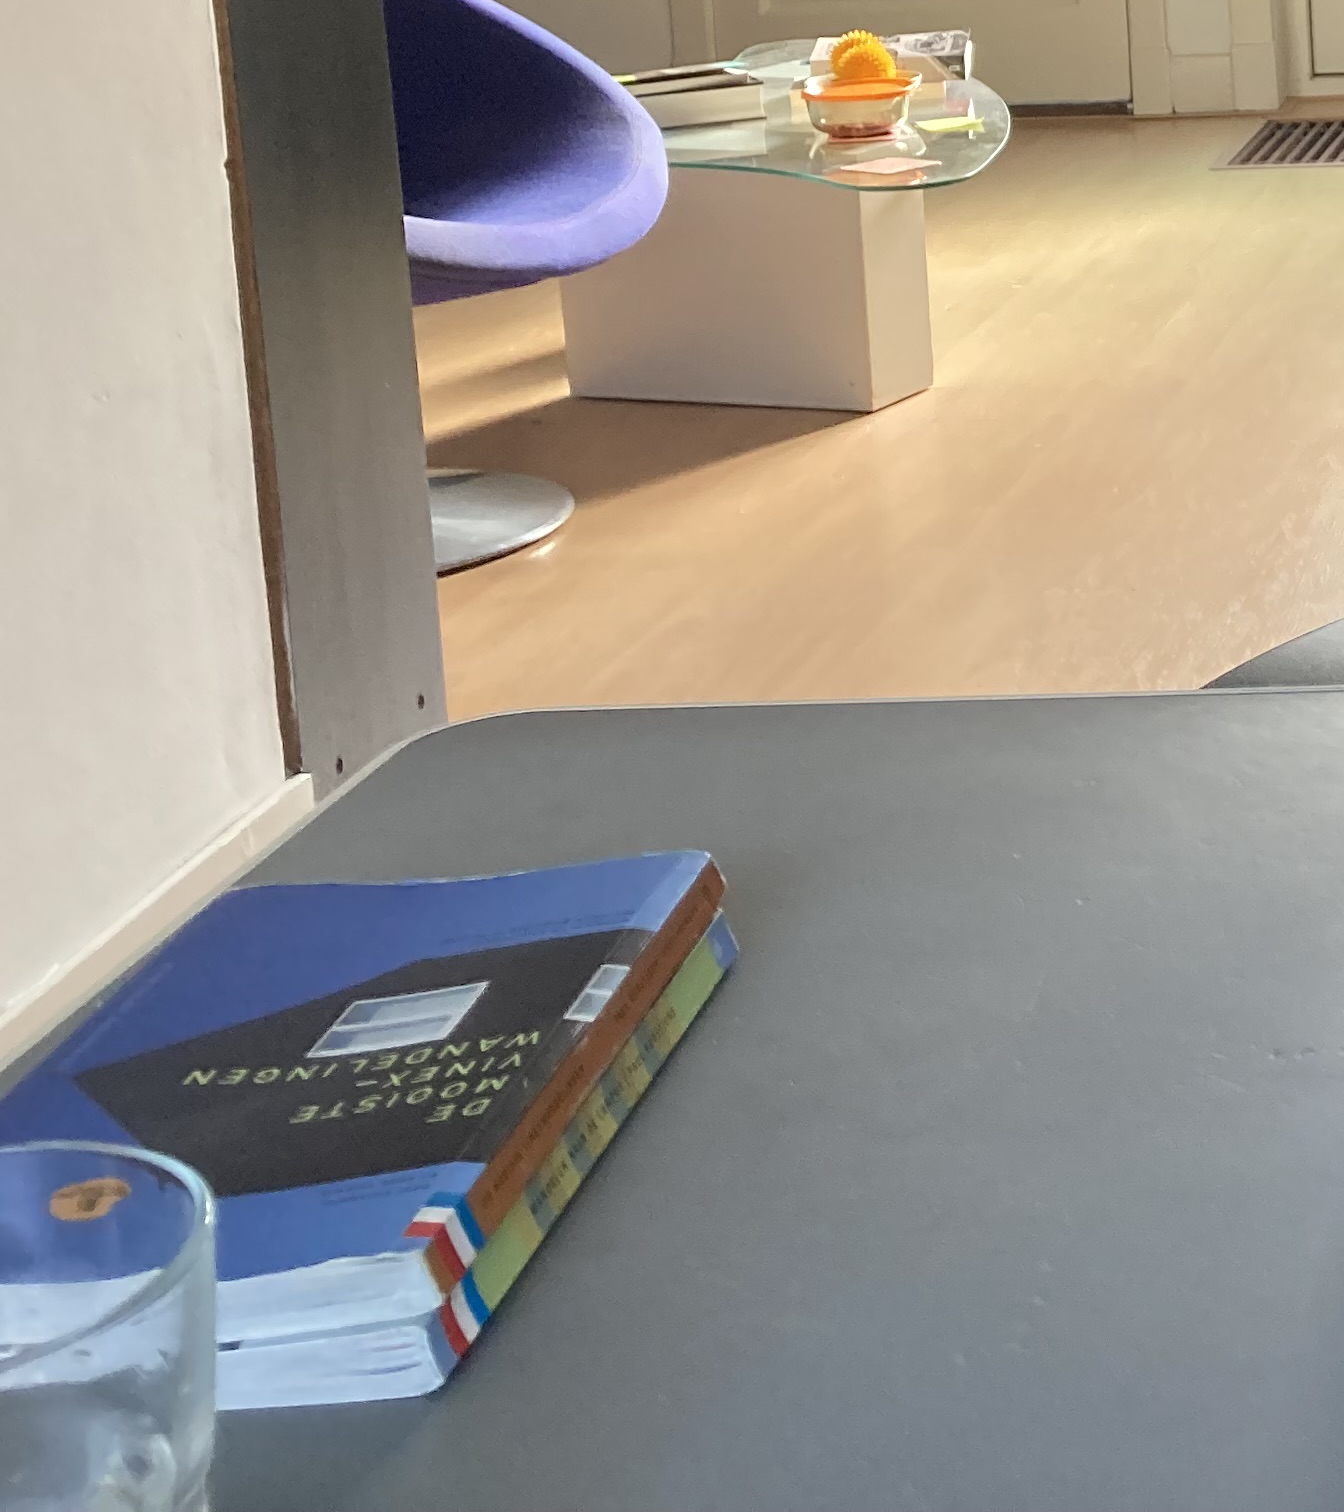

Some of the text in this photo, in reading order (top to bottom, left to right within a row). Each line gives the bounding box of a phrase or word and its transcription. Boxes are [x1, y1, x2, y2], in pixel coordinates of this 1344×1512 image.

[182, 1030, 541, 1086] WANDELINGEN
[354, 1052, 522, 1088] VINEX-
[289, 1074, 509, 1124] MOOISTE
[425, 1097, 492, 1124] DE
